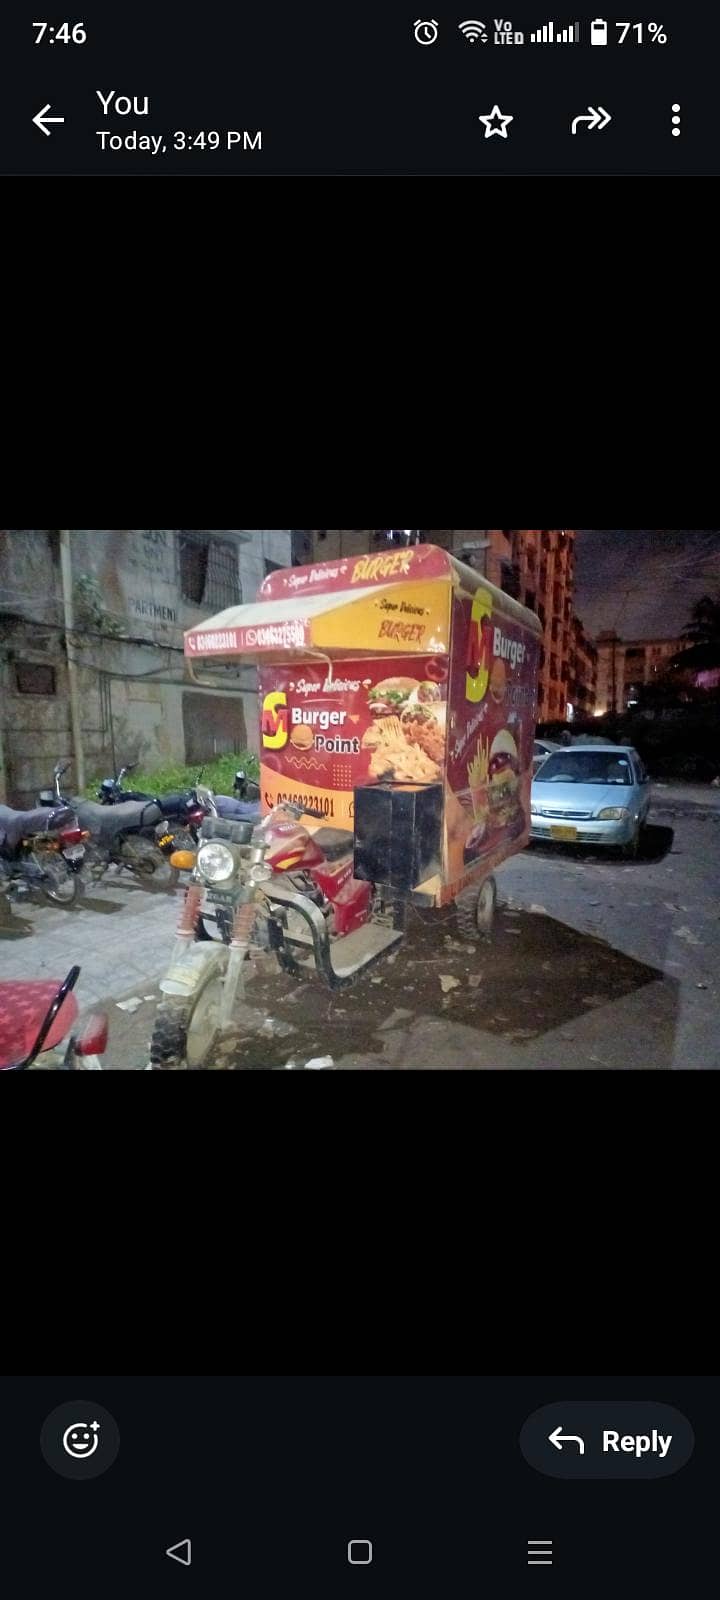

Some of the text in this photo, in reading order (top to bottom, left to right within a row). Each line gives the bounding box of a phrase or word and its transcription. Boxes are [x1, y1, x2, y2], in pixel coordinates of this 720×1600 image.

[350, 551, 414, 584] BURGER
[378, 619, 426, 644] BURGER
[493, 627, 526, 670] Burger
[295, 678, 320, 697] Super
[291, 707, 347, 729] Burger
[314, 734, 360, 754] Point
